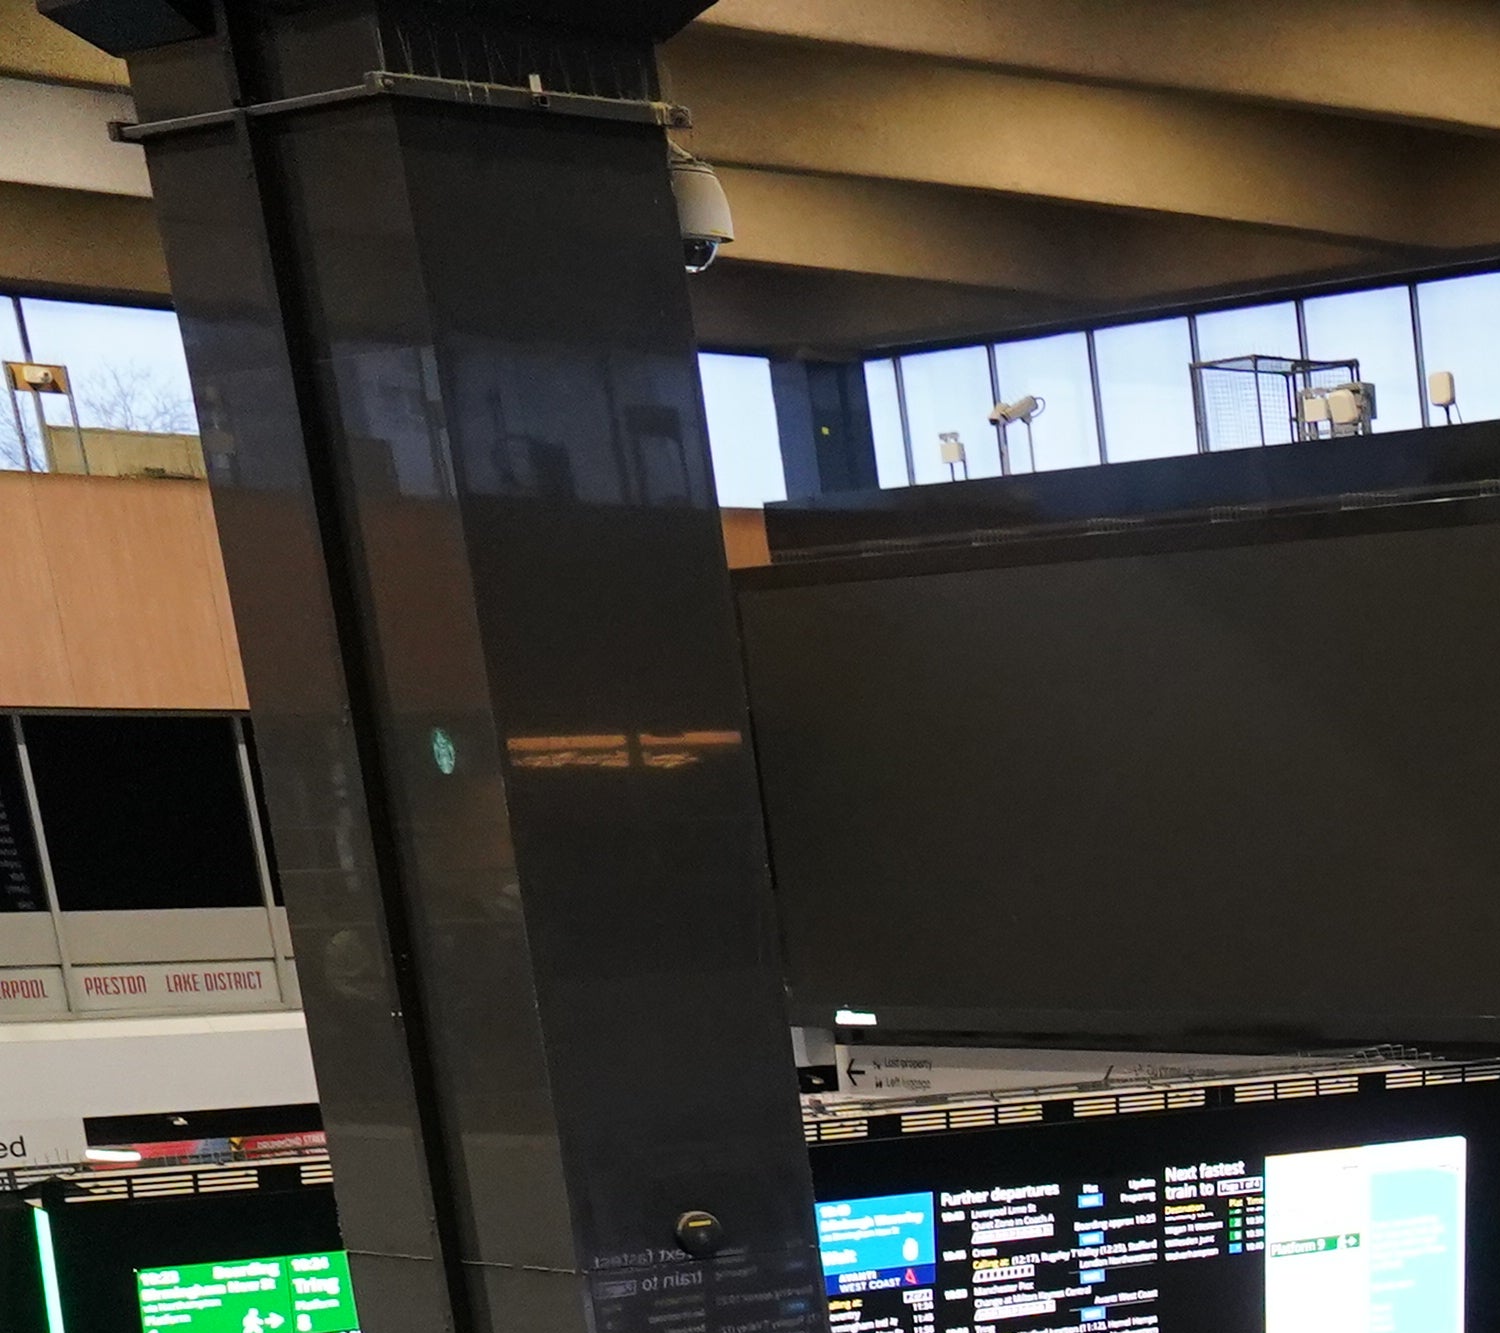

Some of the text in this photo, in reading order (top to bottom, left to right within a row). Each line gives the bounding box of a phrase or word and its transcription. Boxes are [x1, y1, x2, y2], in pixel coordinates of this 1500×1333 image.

[84, 975, 147, 995] PRESTON
[165, 973, 199, 993] LAKE
[204, 971, 262, 991] DISTRICT
[1165, 1161, 1245, 1183] Next fastest
[941, 1183, 1060, 1207] Further departures
[1165, 1183, 1214, 1200] train to
